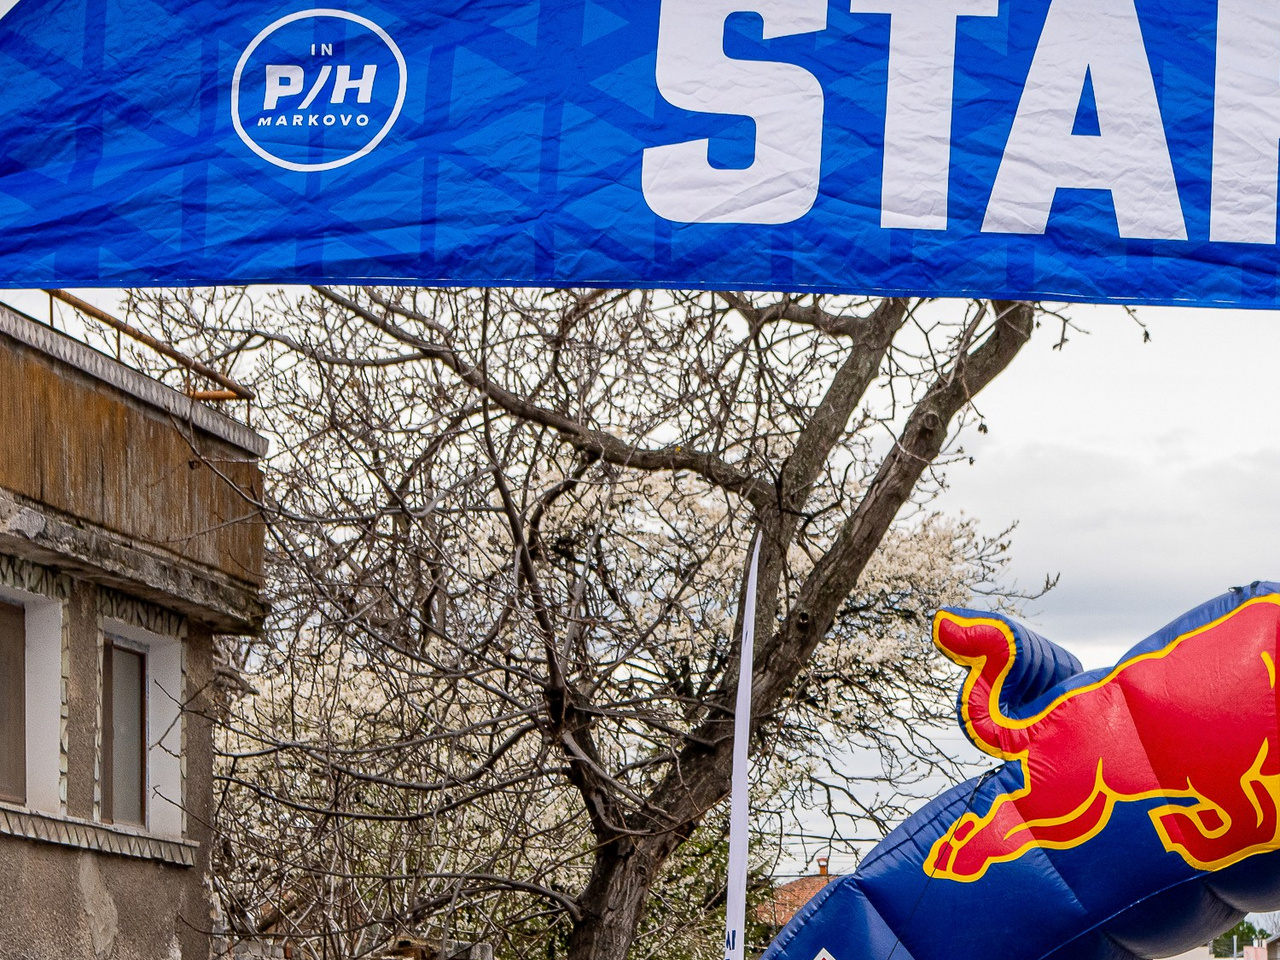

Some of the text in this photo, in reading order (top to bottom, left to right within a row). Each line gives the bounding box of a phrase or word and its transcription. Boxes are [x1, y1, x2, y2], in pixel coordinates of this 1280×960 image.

[310, 43, 333, 56] IN
[263, 64, 377, 110] P/H
[257, 114, 369, 127] MARKOVO
